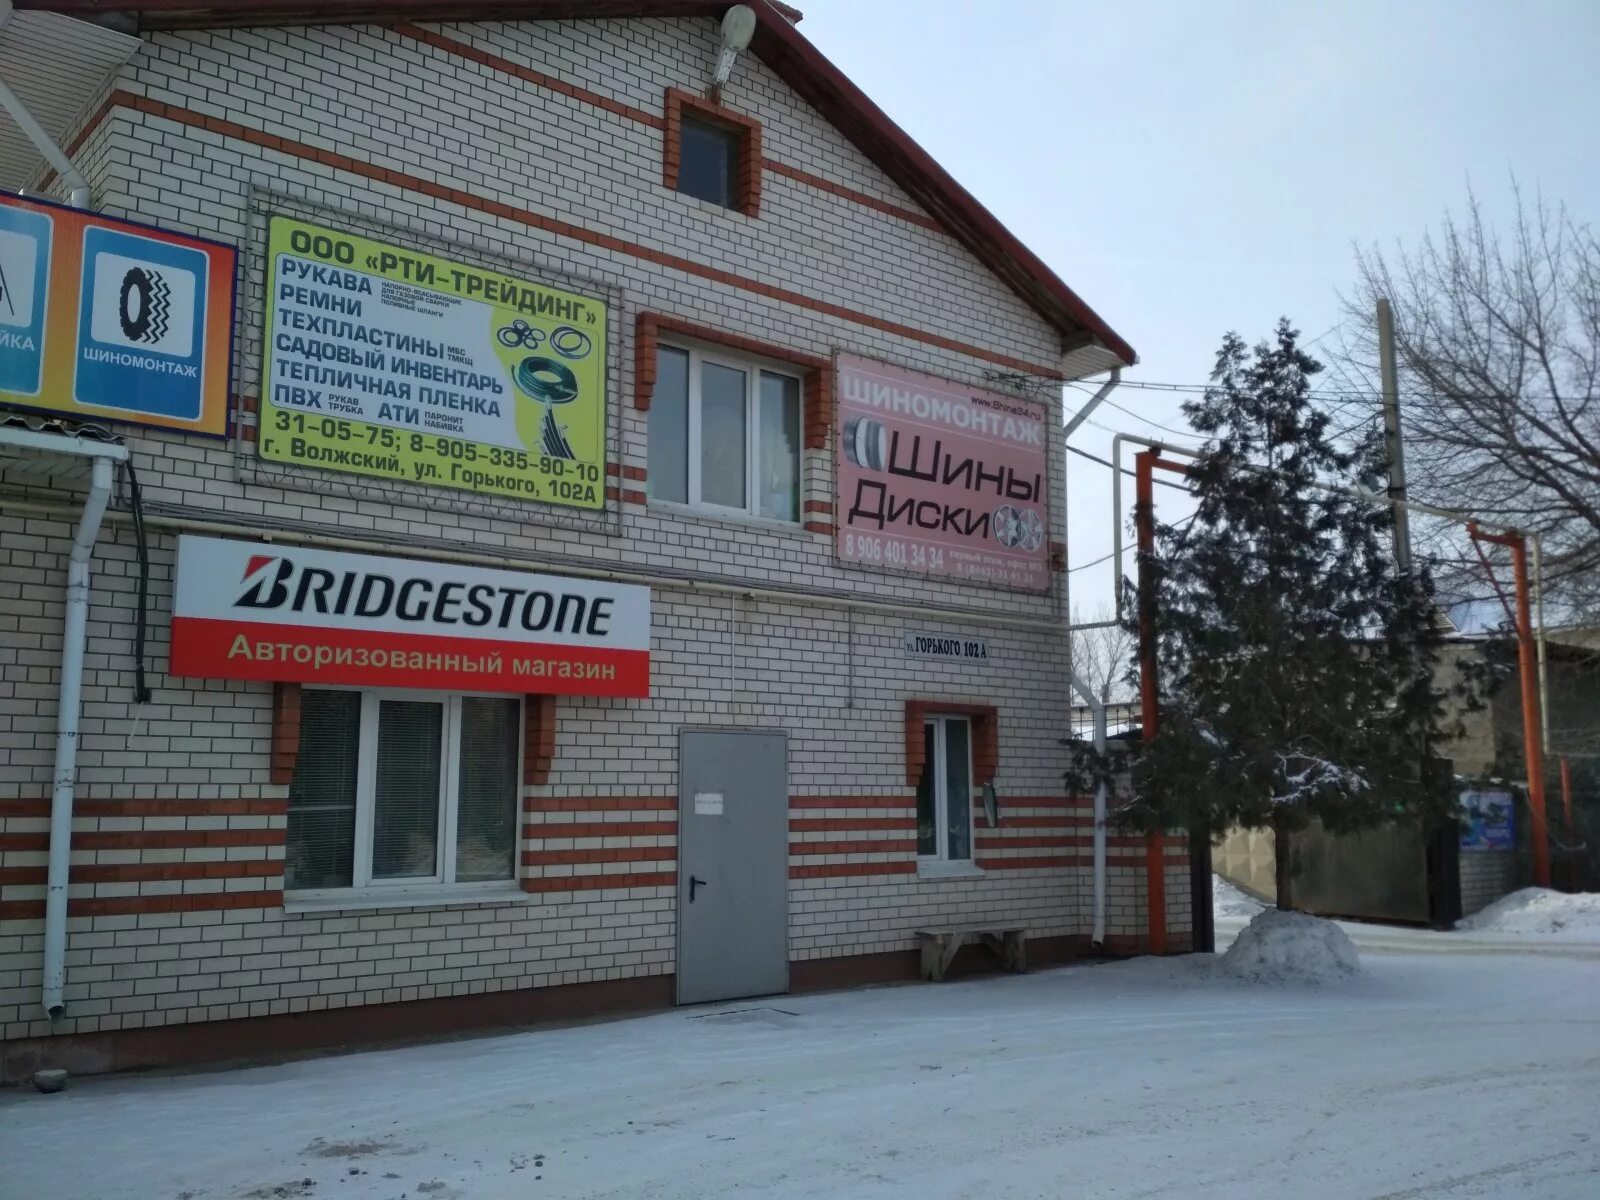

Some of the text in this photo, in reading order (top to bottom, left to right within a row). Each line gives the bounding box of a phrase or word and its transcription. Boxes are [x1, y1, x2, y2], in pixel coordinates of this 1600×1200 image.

[290, 230, 354, 264] ООО
[282, 257, 372, 295] РУКАВА
[280, 283, 362, 317] РЕМНИ
[381, 281, 462, 305] НАПОРНО-ВСАСЫВАЮЩИЕ
[381, 287, 450, 308] ДЛЯ ГАЗОВОЙ СВАРКИ
[381, 293, 416, 305] НАПОРНЫЕ
[381, 298, 444, 318] ПОЛИВНЫЕ ШЛАНГИ
[279, 307, 444, 359] ТЕХПЛАСТИНЫ
[83, 347, 198, 378] ШИНОМОНТАЖ
[276, 333, 503, 395] САДОВЫЙ ИНВЕНТАРЬ
[447, 345, 466, 356] МБС
[447, 353, 473, 367] ТМКЩ
[274, 383, 322, 409] ПВХ
[276, 358, 501, 418] ТЕПЛИЧНАЯ ПЛЕНКА
[328, 393, 359, 406] РУКАВ
[328, 402, 364, 415] ТРУБКА
[377, 402, 419, 425] АТИ
[424, 411, 464, 424] ПАРОНИТ
[841, 375, 1041, 445] ШИНОМОНТАЖ
[424, 420, 464, 433] НАБИВКА
[264, 437, 596, 503] г. Волжский, ул. Горького, 102А
[410, 433, 599, 483] 8-905-335-90-10
[846, 533, 944, 568] 8 906 401 34 34
[231, 554, 615, 636] BRIDGESTONE
[227, 633, 616, 681] Авторизованный магазин
[915, 636, 960, 656] ГОРЬКОГО
